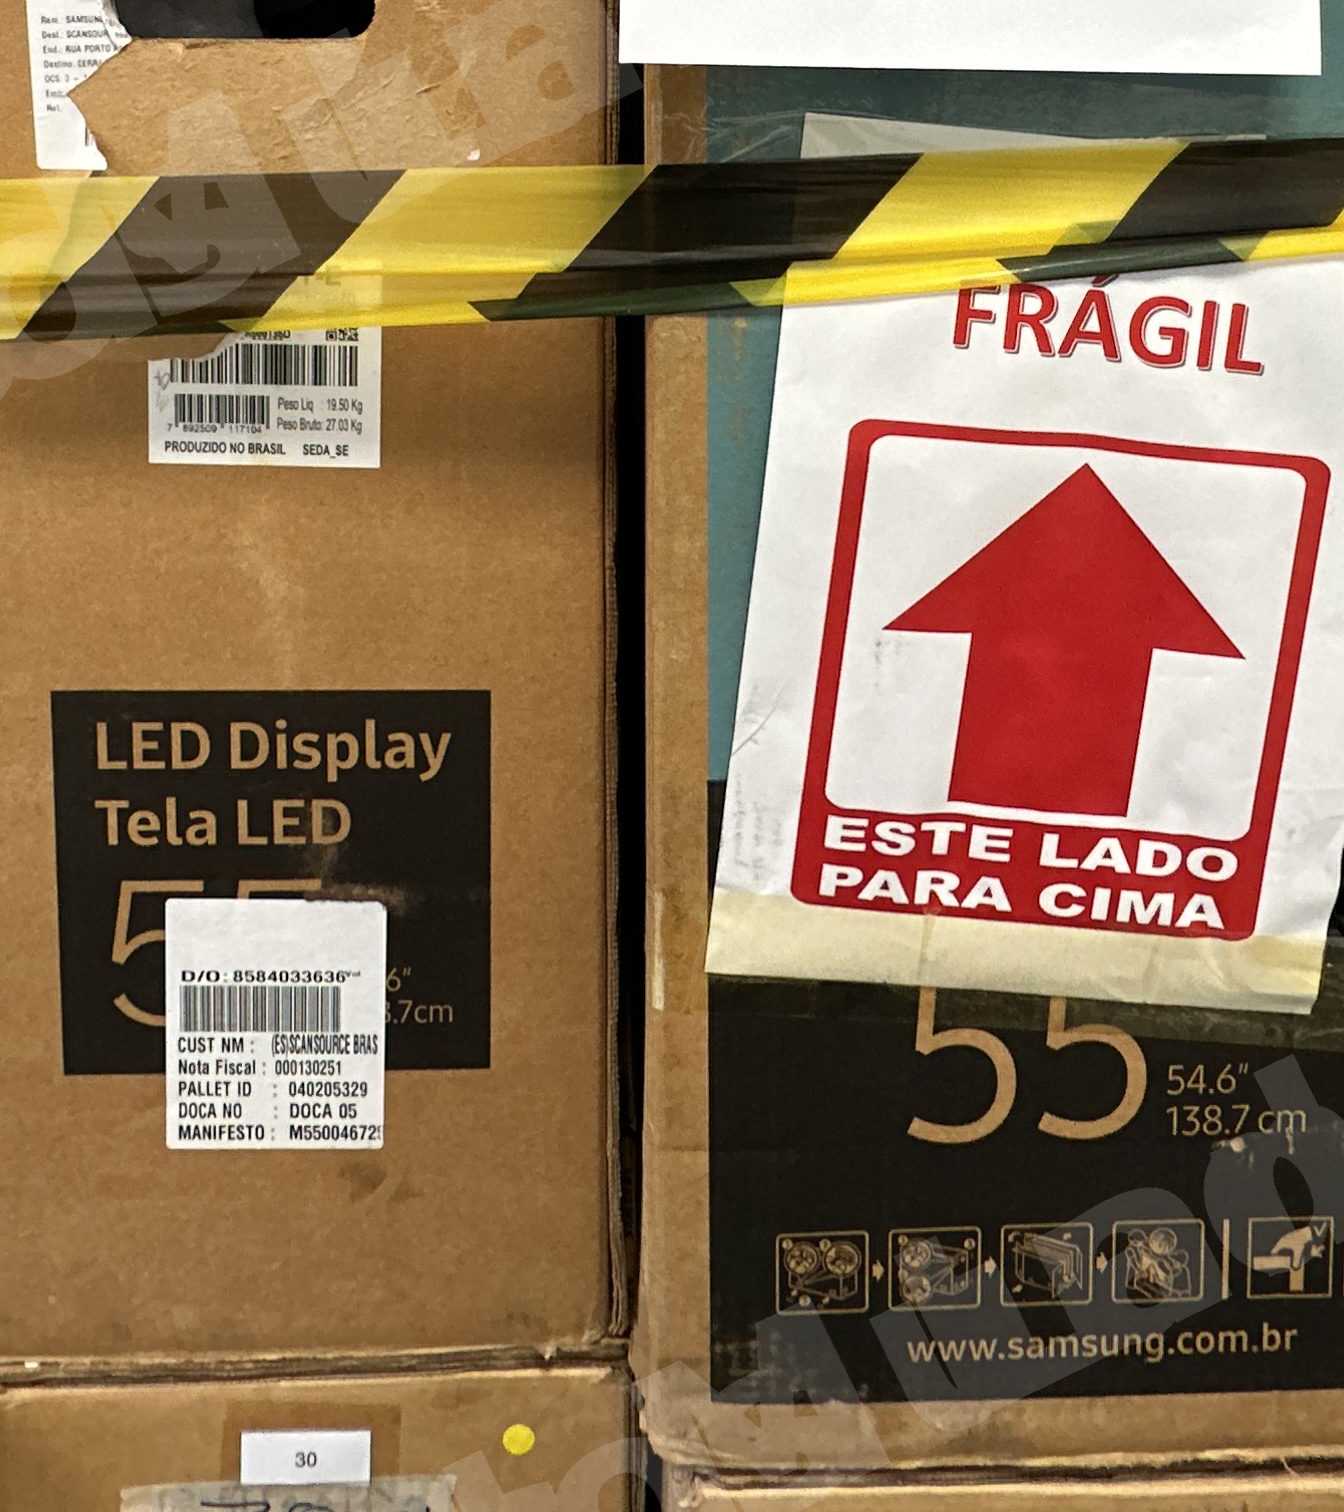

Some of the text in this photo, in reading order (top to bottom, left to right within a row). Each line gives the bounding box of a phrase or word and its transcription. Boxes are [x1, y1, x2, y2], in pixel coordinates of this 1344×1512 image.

[952, 277, 1265, 375] FRÁGIL
[278, 397, 363, 414] Peso 19.50 Kg
[277, 418, 297, 430] Peso
[350, 420, 362, 435] Kg
[165, 441, 349, 458] PRODUZIDO NO BRASIL SEDA_SE
[96, 719, 451, 783] LED Display
[94, 797, 351, 846] Tela LED
[823, 816, 1012, 864] ESTE
[1038, 832, 1240, 882] LADO
[818, 866, 1225, 931] PARA CIMA
[233, 971, 346, 983] 8584033636
[178, 1038, 244, 1053] CUST NM
[354, 1035, 378, 1054] BRAS
[179, 1059, 341, 1075] Nota Fiscal 000130251
[179, 1082, 367, 1097] PALLET ID 040205329
[179, 1103, 356, 1118] DOCA NO DOCA 05
[1166, 1105, 1307, 1136] 138.7 cm
[179, 1125, 264, 1140] MANIFESTO
[907, 1323, 1298, 1363] www.samsung.com.br
[295, 1452, 317, 1467] 30
